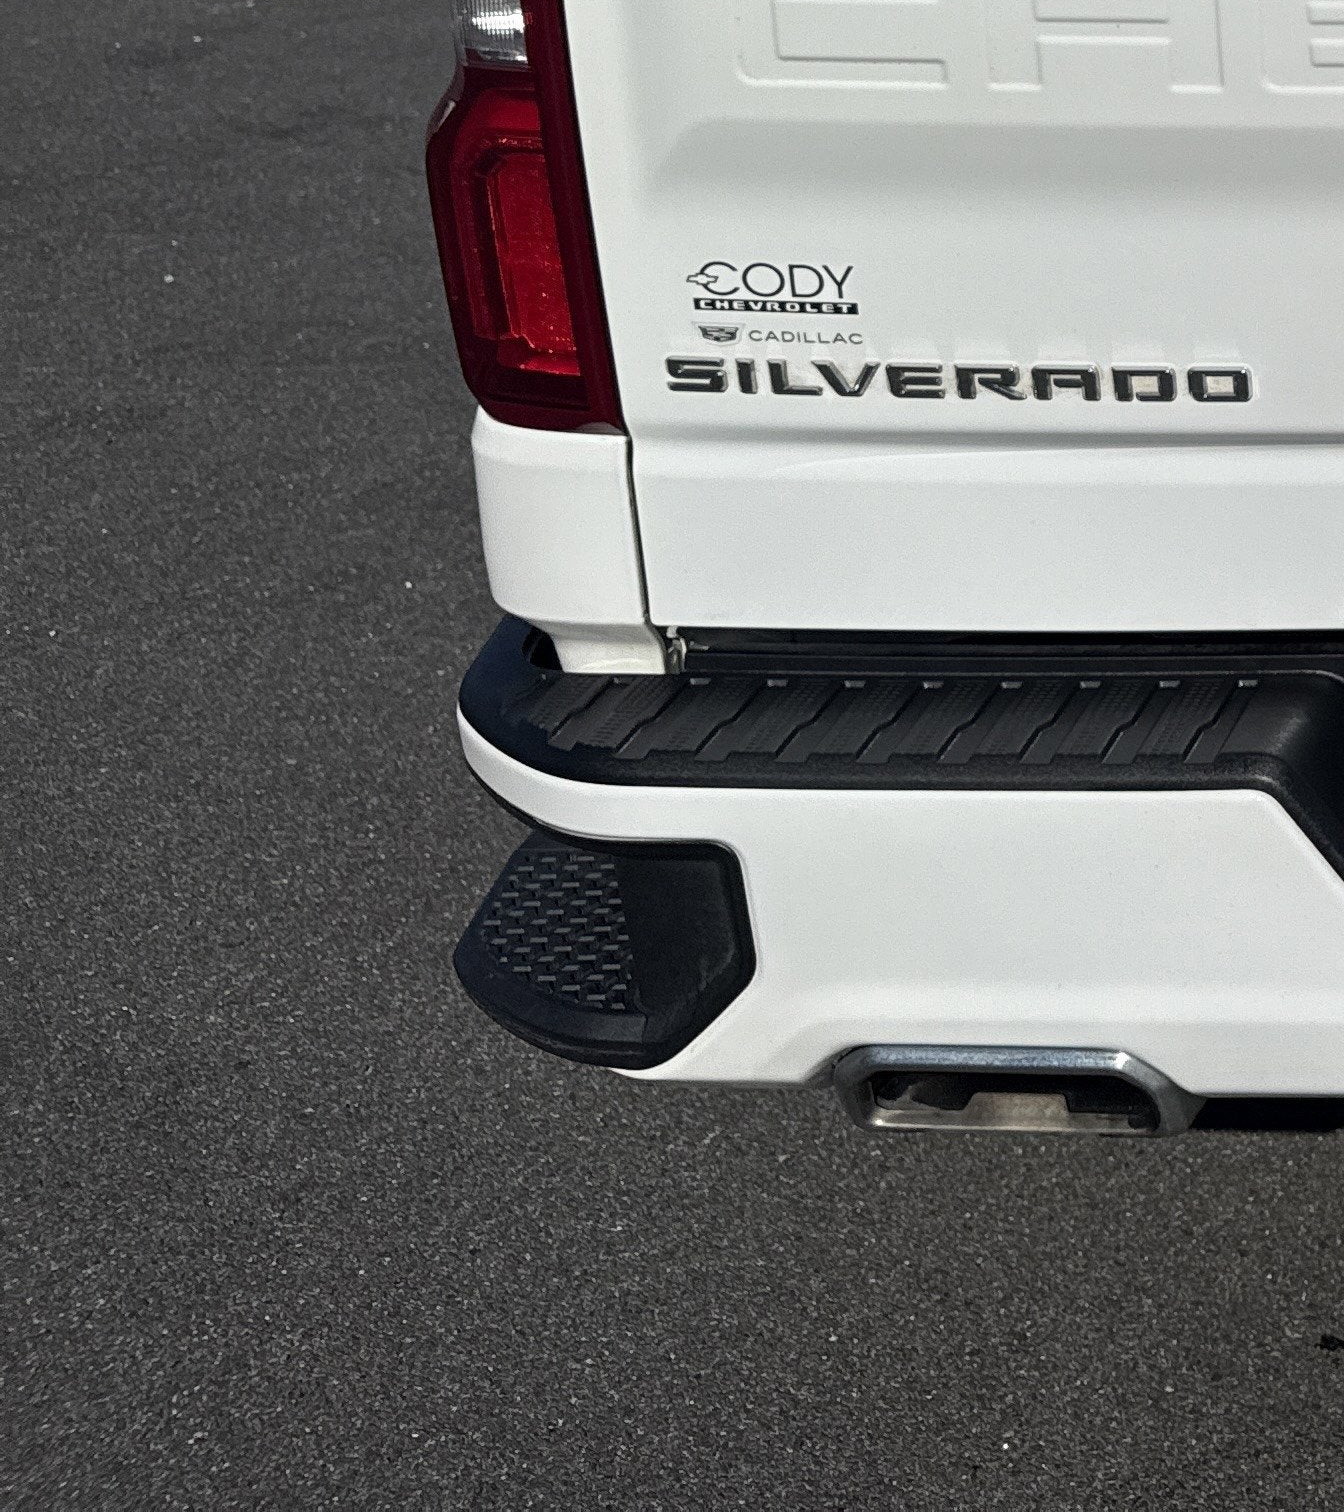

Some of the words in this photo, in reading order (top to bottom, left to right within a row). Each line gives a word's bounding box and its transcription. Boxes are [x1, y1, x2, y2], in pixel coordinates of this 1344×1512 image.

[697, 261, 854, 299] CODY
[697, 299, 854, 314] CHEVROLET
[747, 329, 864, 345] CADILLAC
[664, 355, 1255, 402] SILVERADO
